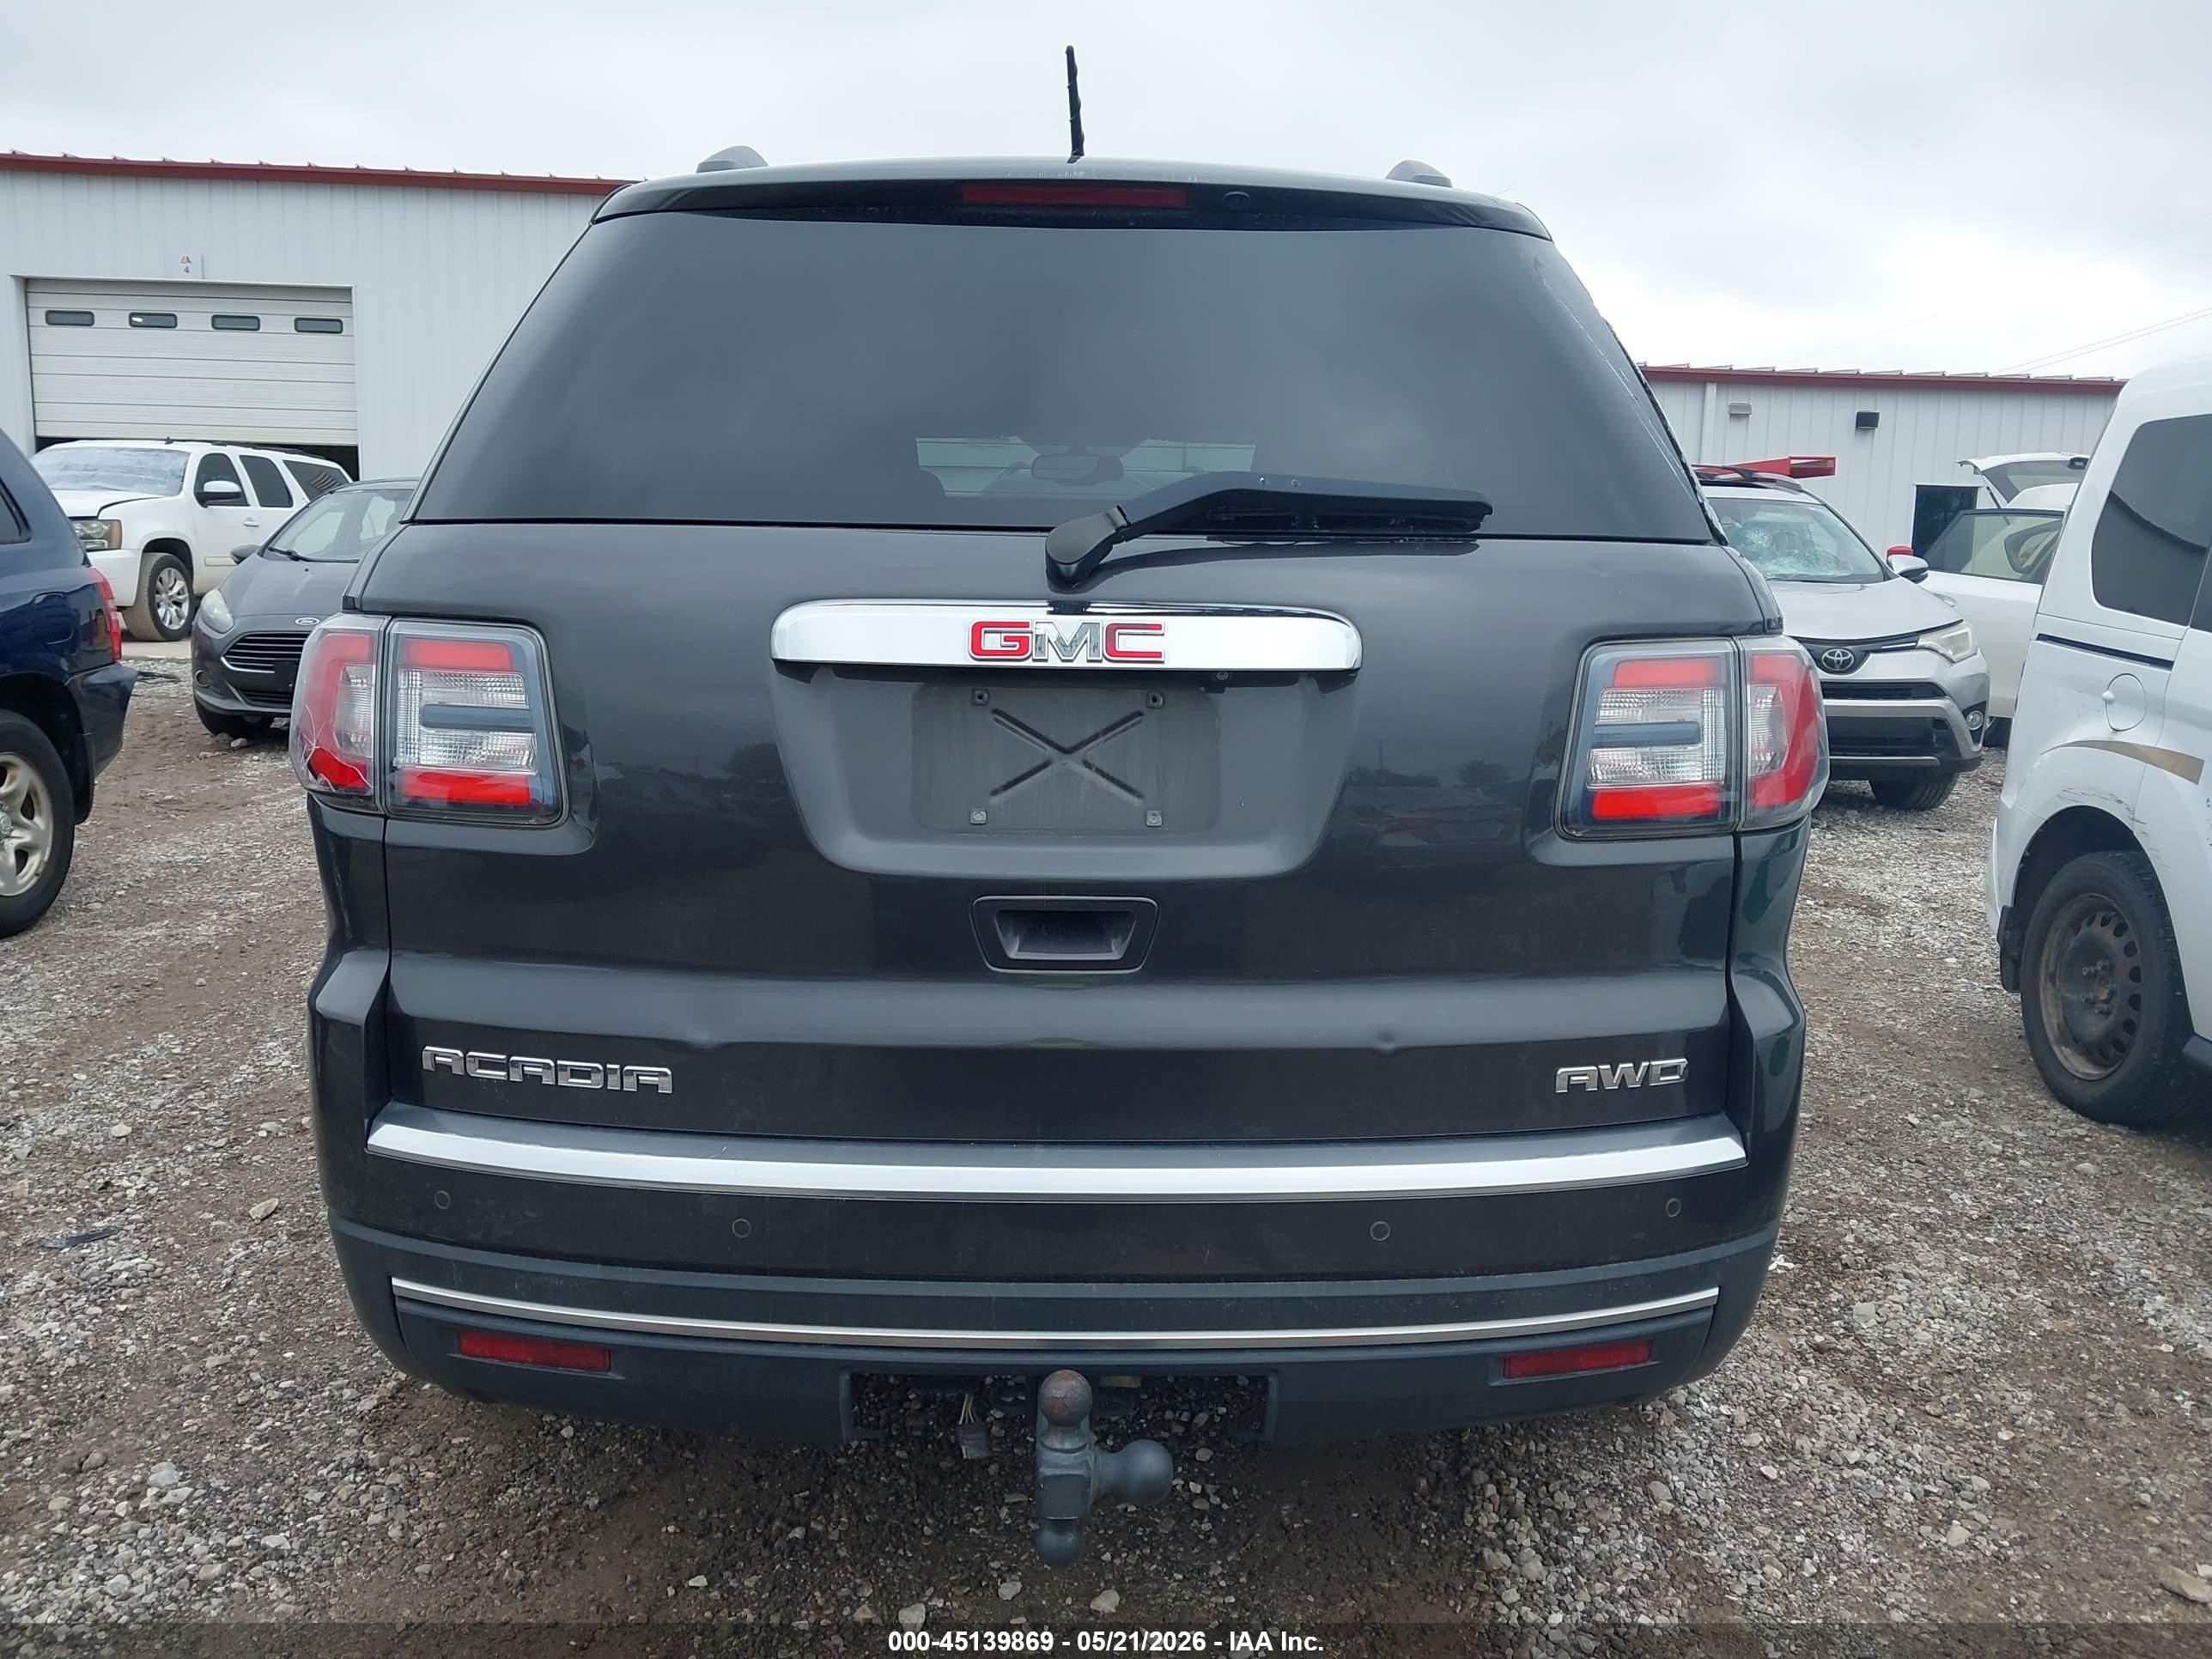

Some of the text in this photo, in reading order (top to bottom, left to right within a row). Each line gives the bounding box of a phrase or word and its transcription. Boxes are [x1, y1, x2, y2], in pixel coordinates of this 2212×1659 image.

[969, 620, 1164, 663] GMC
[422, 1045, 673, 1094] ACADIA
[1555, 1058, 1689, 1093] AWD
